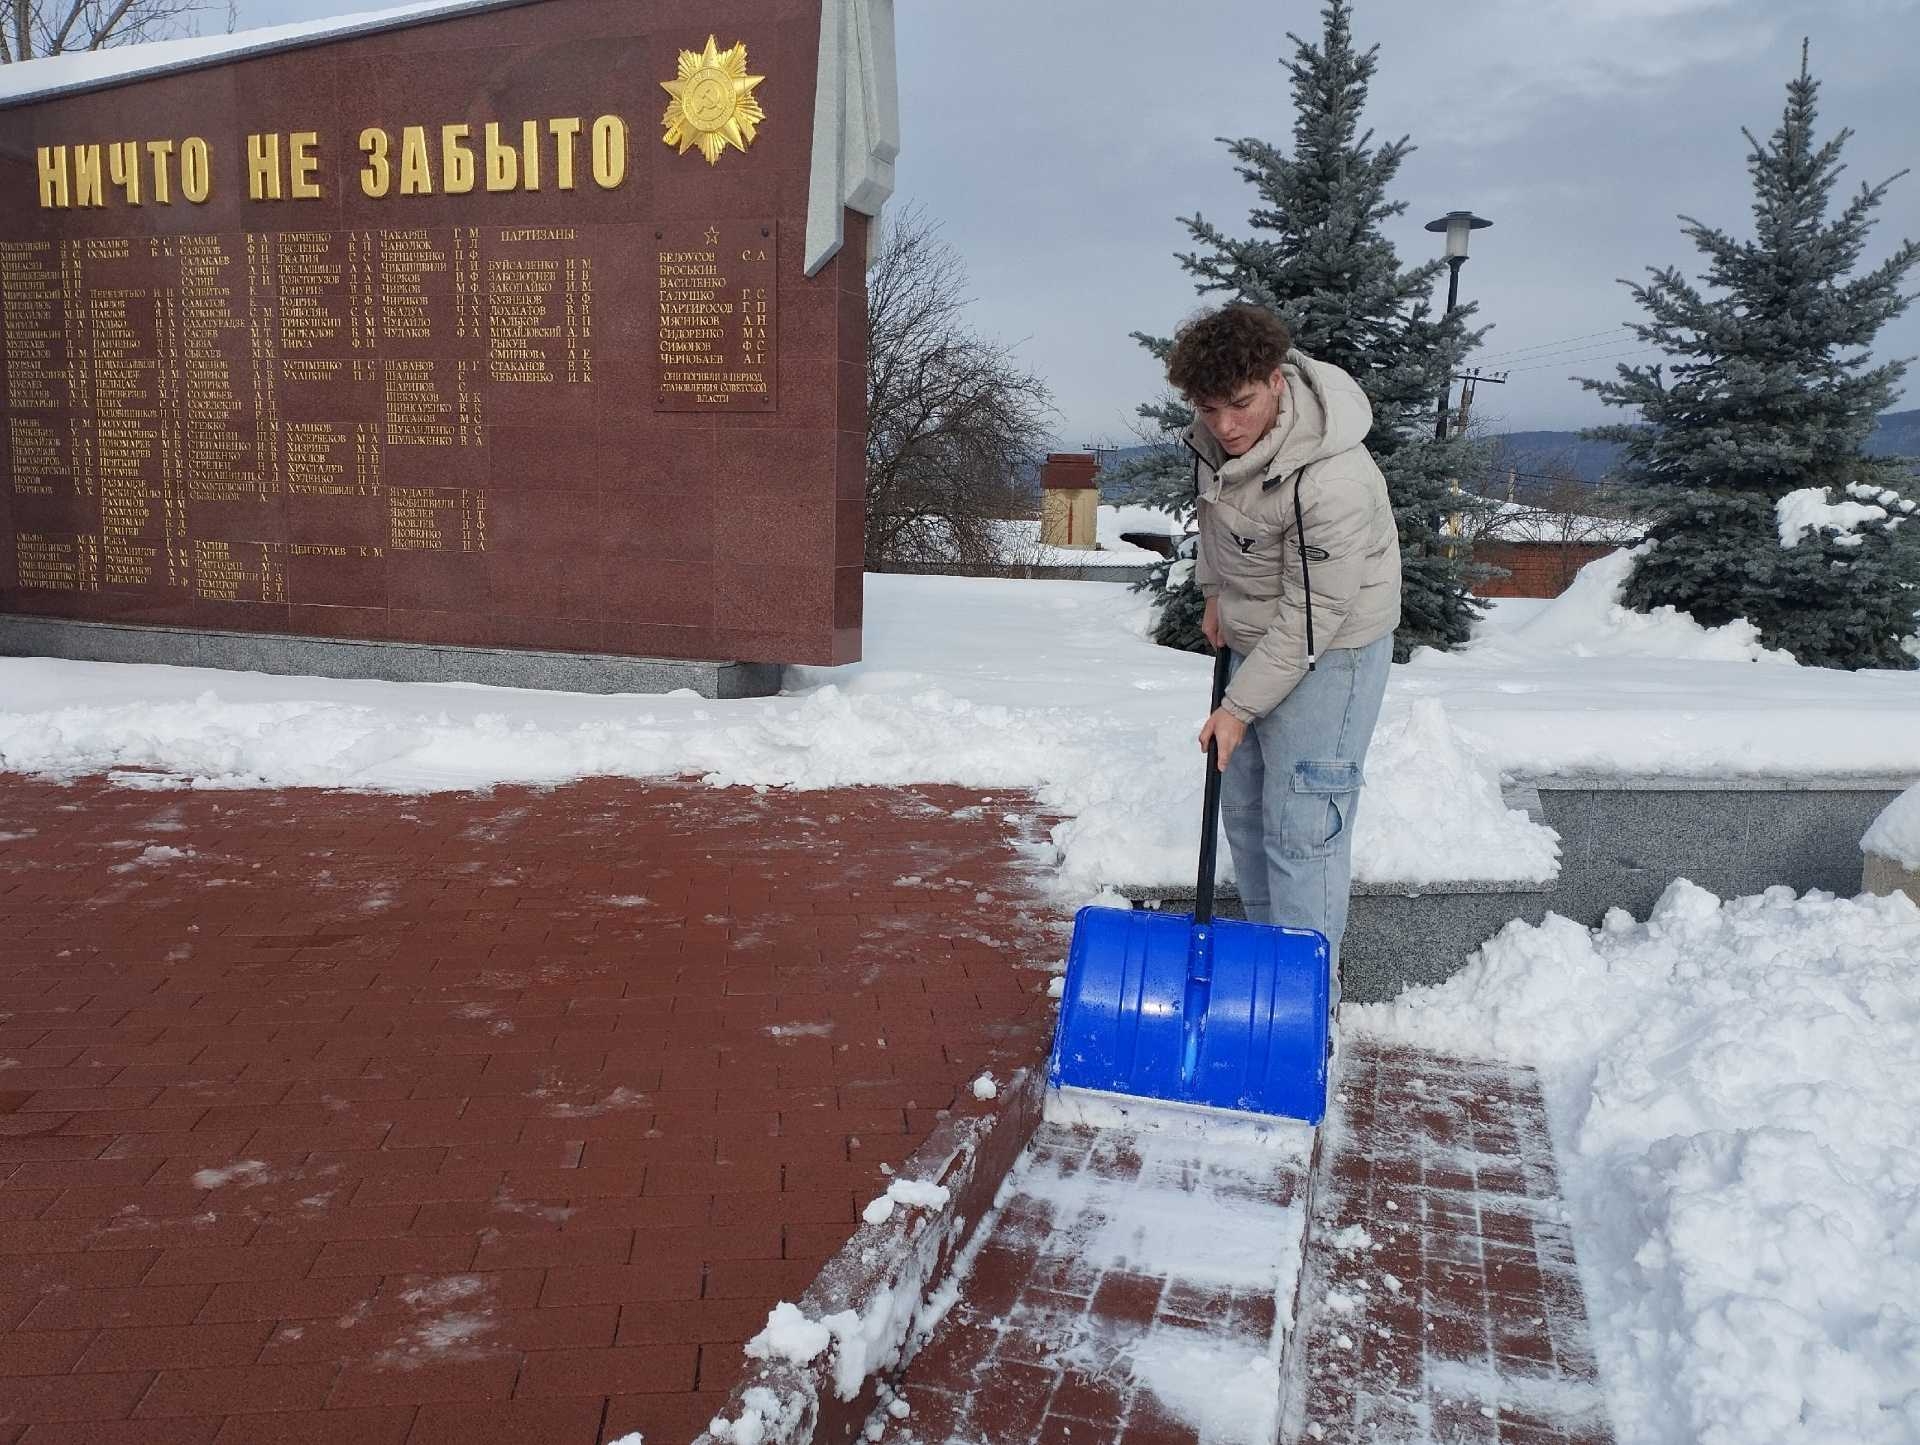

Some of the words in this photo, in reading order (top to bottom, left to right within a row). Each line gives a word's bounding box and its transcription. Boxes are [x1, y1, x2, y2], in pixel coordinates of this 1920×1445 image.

[37, 137, 209, 207] НИЧТО
[248, 132, 320, 201] НЕ
[360, 115, 627, 198] ЗАБЫТО
